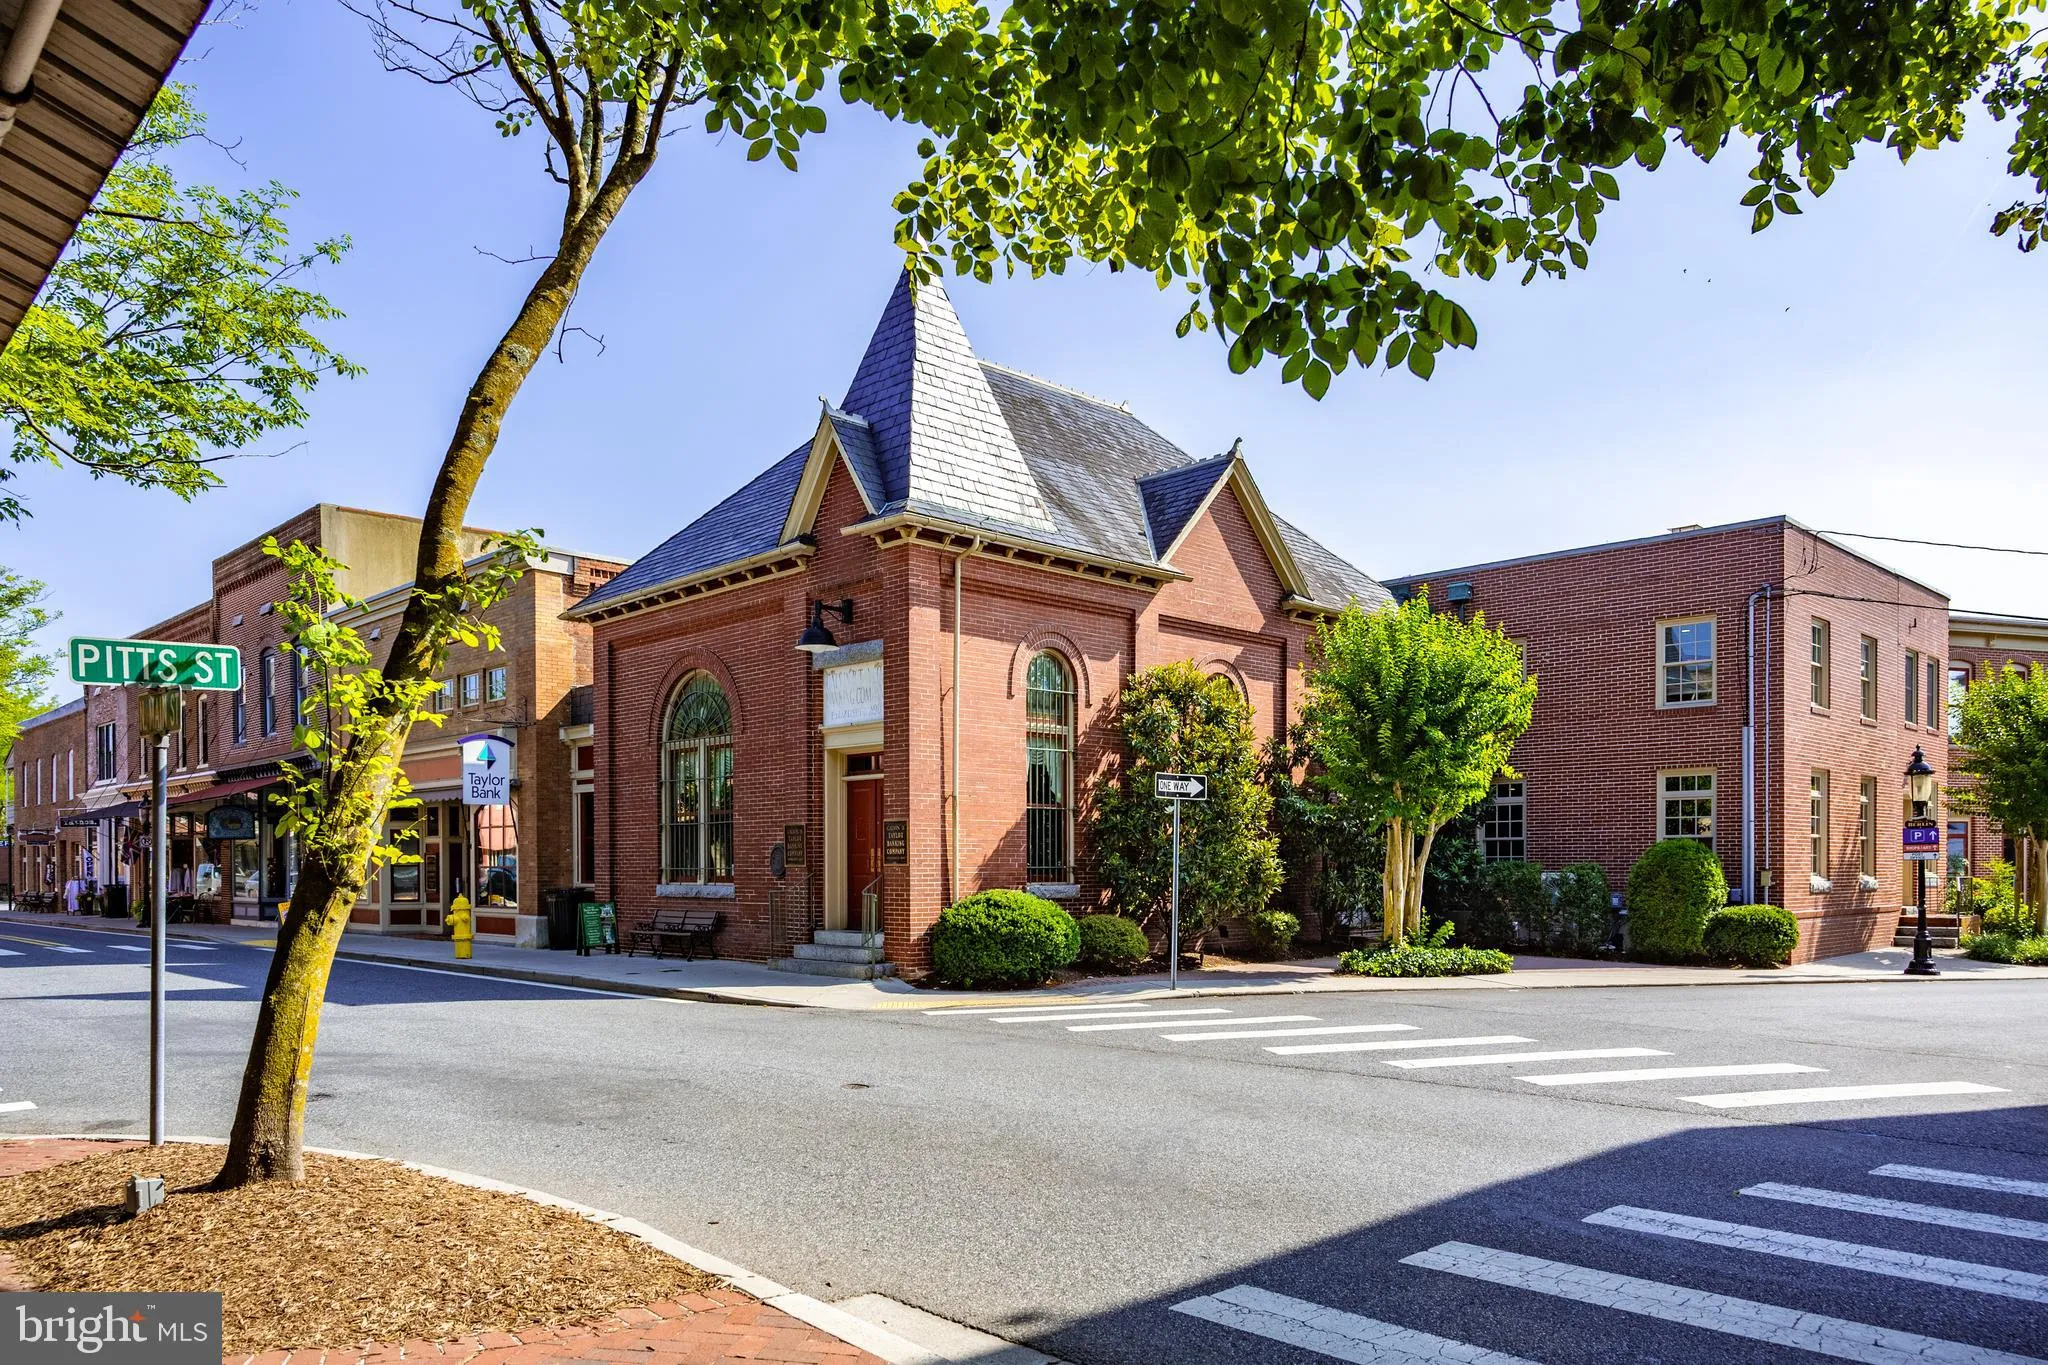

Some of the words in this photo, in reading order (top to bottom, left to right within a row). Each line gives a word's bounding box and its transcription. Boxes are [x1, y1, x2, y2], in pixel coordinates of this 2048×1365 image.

[77, 643, 178, 682] PITTS
[193, 651, 233, 685] ST
[468, 772, 505, 788] Taylor
[1160, 781, 1171, 790] ONE
[1173, 781, 1189, 791] WAY
[471, 785, 501, 799] Bank
[1914, 831, 1922, 840] P
